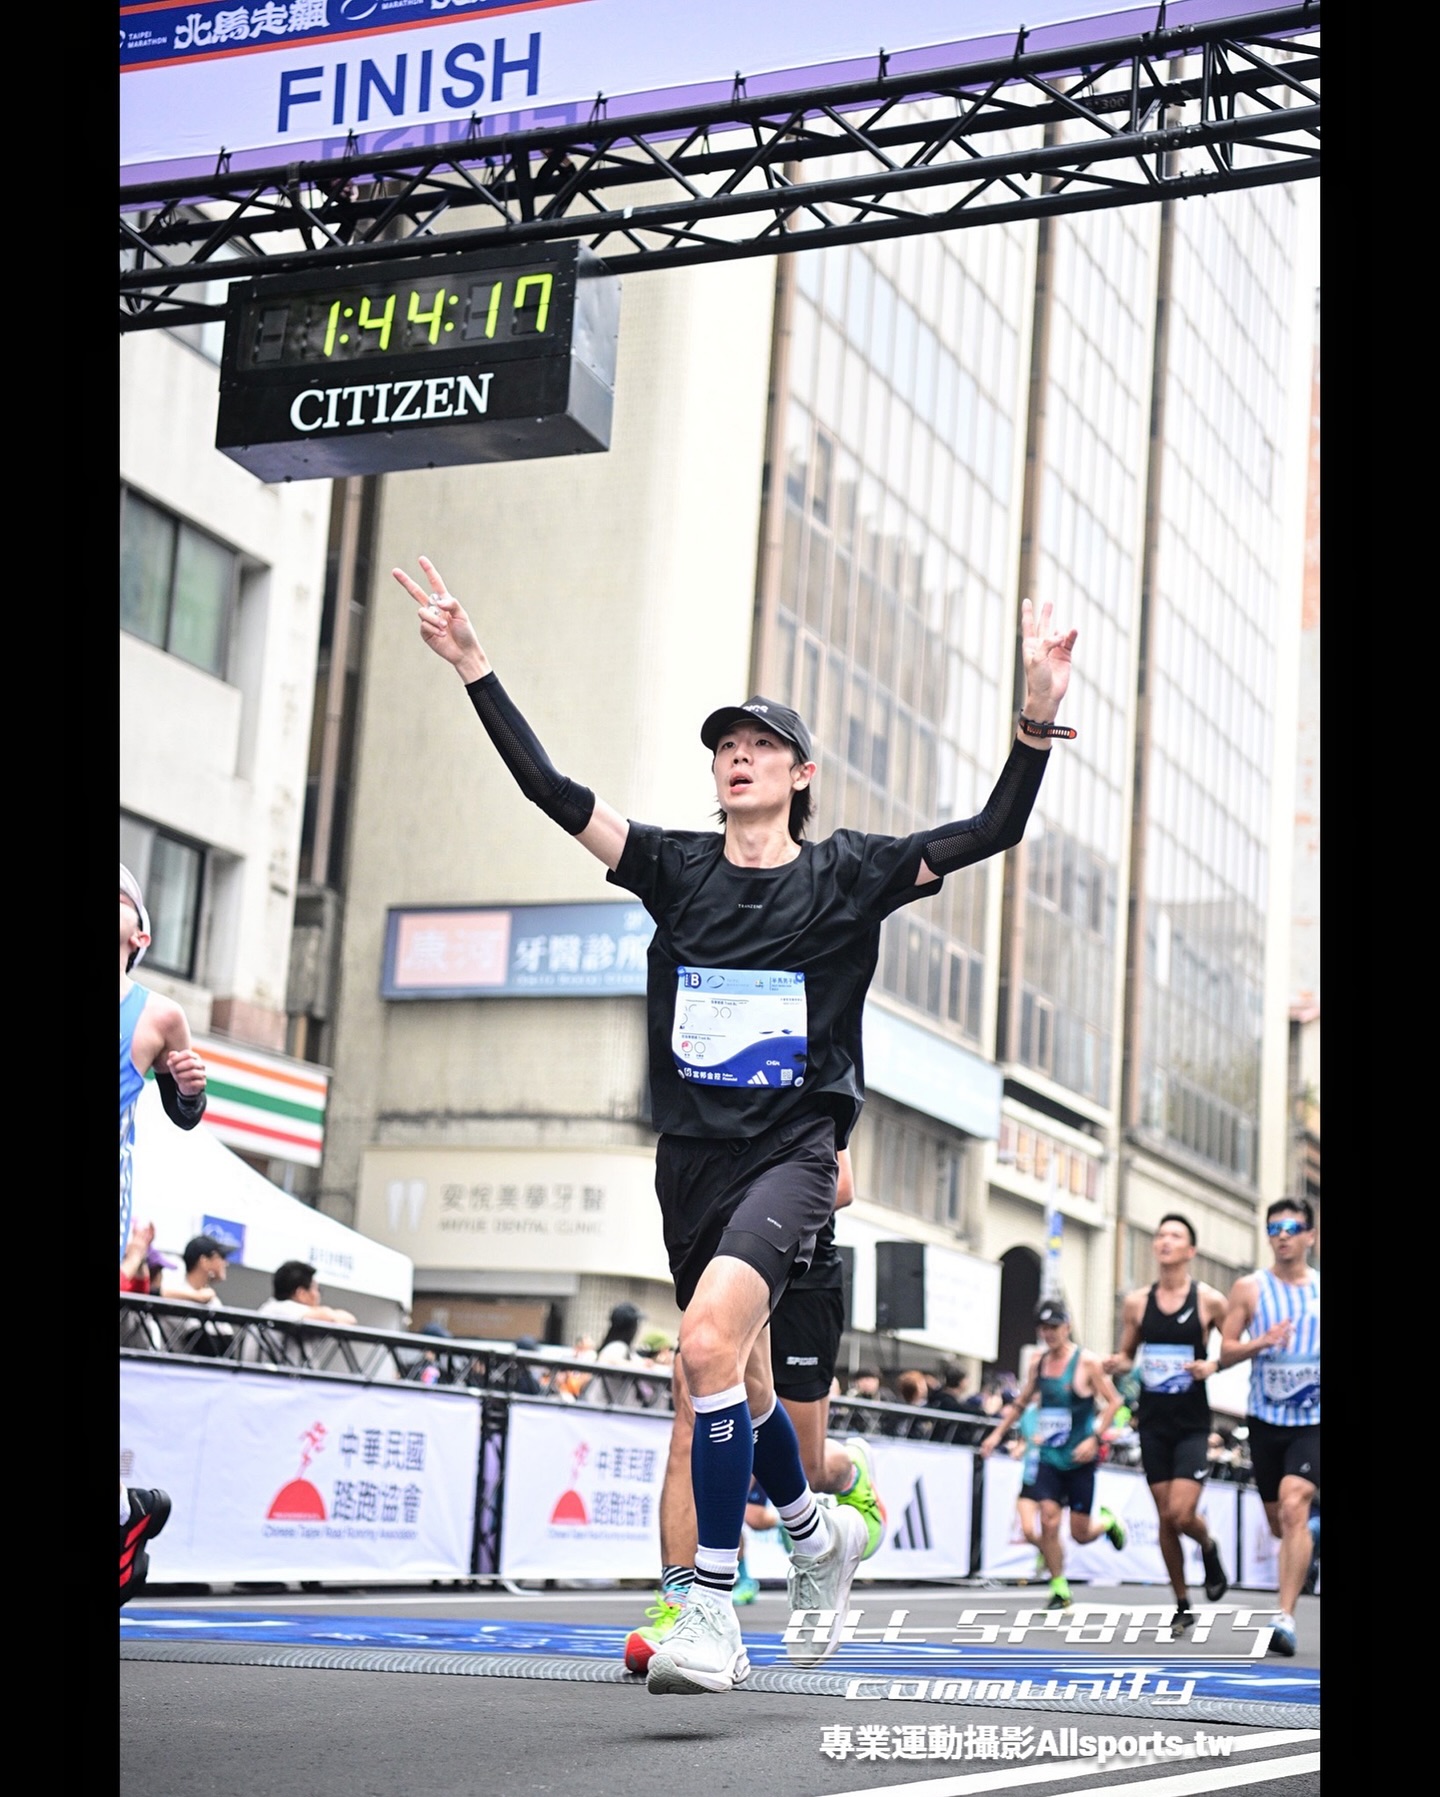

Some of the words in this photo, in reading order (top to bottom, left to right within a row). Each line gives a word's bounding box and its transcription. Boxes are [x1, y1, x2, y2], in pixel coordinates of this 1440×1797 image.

[127, 36, 168, 48] MARATHON
[128, 31, 152, 40] TAIPEI
[277, 32, 541, 133] FINISH
[323, 273, 553, 357] 1:44:17
[290, 373, 494, 431] CITIZEN
[690, 973, 700, 986] B
[339, 1427, 426, 1472] 中華民國
[331, 1480, 423, 1524] 路跑協會
